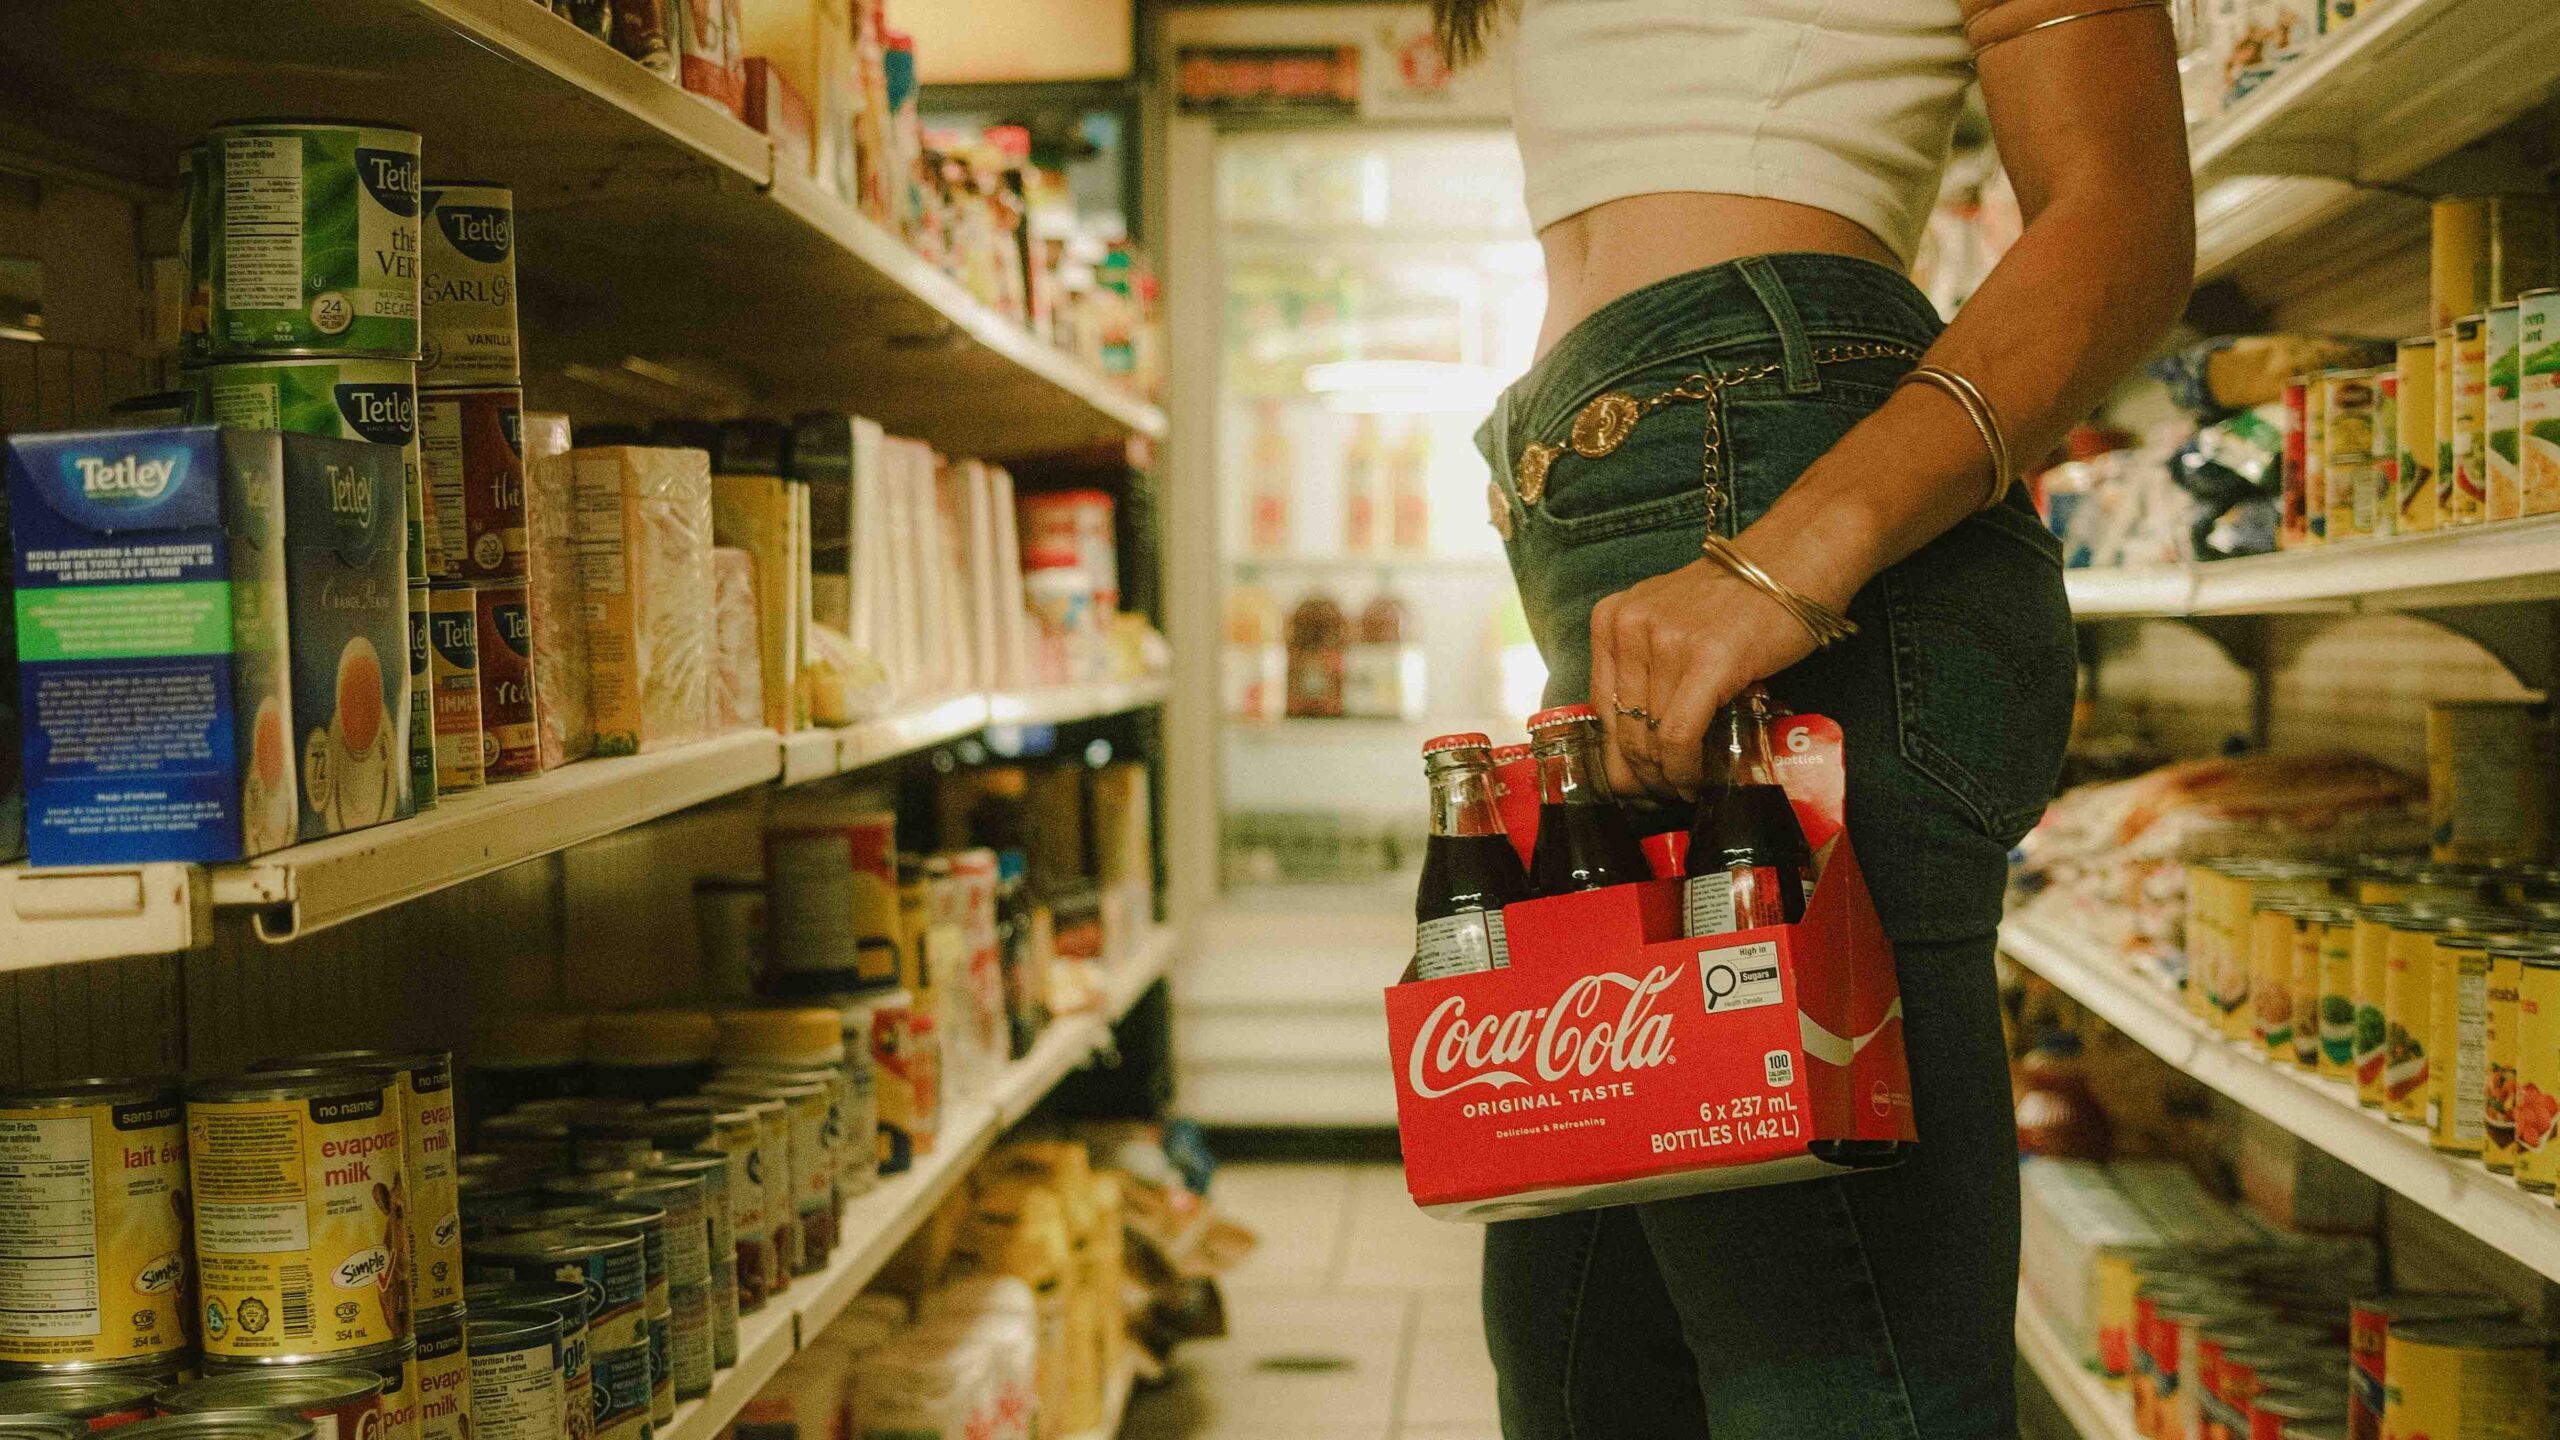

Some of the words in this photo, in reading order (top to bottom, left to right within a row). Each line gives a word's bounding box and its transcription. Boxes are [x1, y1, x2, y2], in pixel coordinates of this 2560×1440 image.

[376, 250, 419, 279] VER
[421, 273, 490, 307] EARL
[321, 300, 342, 314] 24
[76, 456, 175, 500] Tetley
[326, 465, 373, 529] Tetley
[27, 551, 57, 562] NOUS
[134, 547, 158, 558] NOS
[159, 544, 213, 556] PRODUITS
[91, 558, 119, 569] TOUS
[1786, 726, 1810, 753] 6
[312, 751, 326, 780] 72
[1739, 947, 1758, 958] High
[1760, 945, 1767, 954] in
[1742, 971, 1770, 982] Sugars
[1409, 962, 1685, 1099] Coca-Cola
[1769, 1054, 1789, 1069] 100
[418, 1077, 432, 1088] no
[1769, 1069, 1791, 1077] CALORIES
[320, 1106, 338, 1118] no
[341, 1100, 376, 1115] name
[1463, 1092, 1562, 1119] ORIGINAL
[1569, 1082, 1635, 1104] TASTE
[1700, 1102, 1712, 1122] 6
[1717, 1105, 1728, 1121] x
[1731, 1096, 1762, 1120] 237
[1768, 1092, 1799, 1114] mL
[122, 1109, 153, 1125] sans
[1496, 1125, 1541, 1140] Delicious
[1543, 1124, 1551, 1133] &
[1552, 1117, 1607, 1134] Refreshing
[1651, 1126, 1733, 1154] BOTTLES
[1737, 1118, 1781, 1146] (1.42
[1782, 1114, 1800, 1139] L)
[124, 1147, 156, 1169] lait
[325, 1161, 372, 1187] milk
[142, 1259, 180, 1290] Simple
[341, 1251, 386, 1284] Simple
[133, 1337, 149, 1348] 354
[336, 1330, 353, 1342] 354
[355, 1328, 369, 1339] mL
[419, 1343, 434, 1354] no
[436, 1337, 460, 1351] name
[472, 1357, 505, 1368] Nutrition
[506, 1354, 524, 1365] Facts
[473, 1367, 497, 1377] Valeur
[499, 1363, 527, 1374] nutritive
[564, 1339, 586, 1379] gle
[424, 1394, 460, 1420] milk
